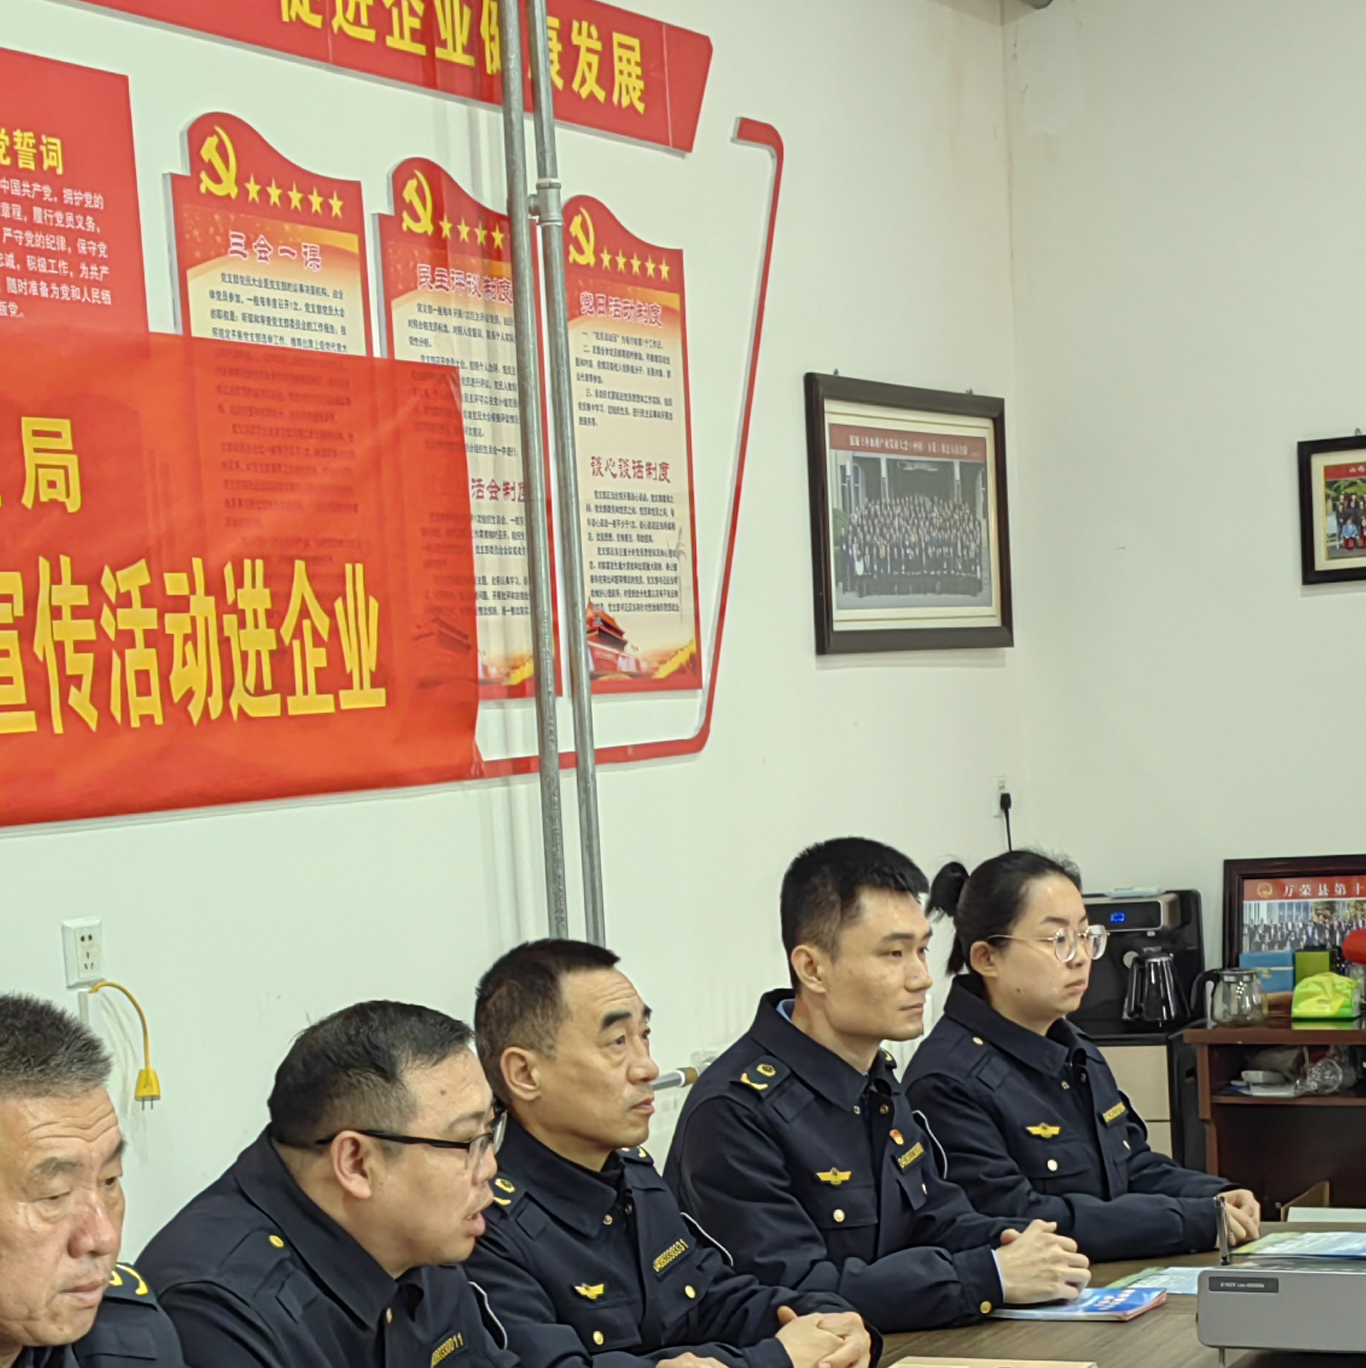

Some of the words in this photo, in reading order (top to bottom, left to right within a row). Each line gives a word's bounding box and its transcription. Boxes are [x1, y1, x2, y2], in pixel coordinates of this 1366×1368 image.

[227, 230, 322, 272] 三会一课
[590, 456, 672, 484] 谈心谈话制度
